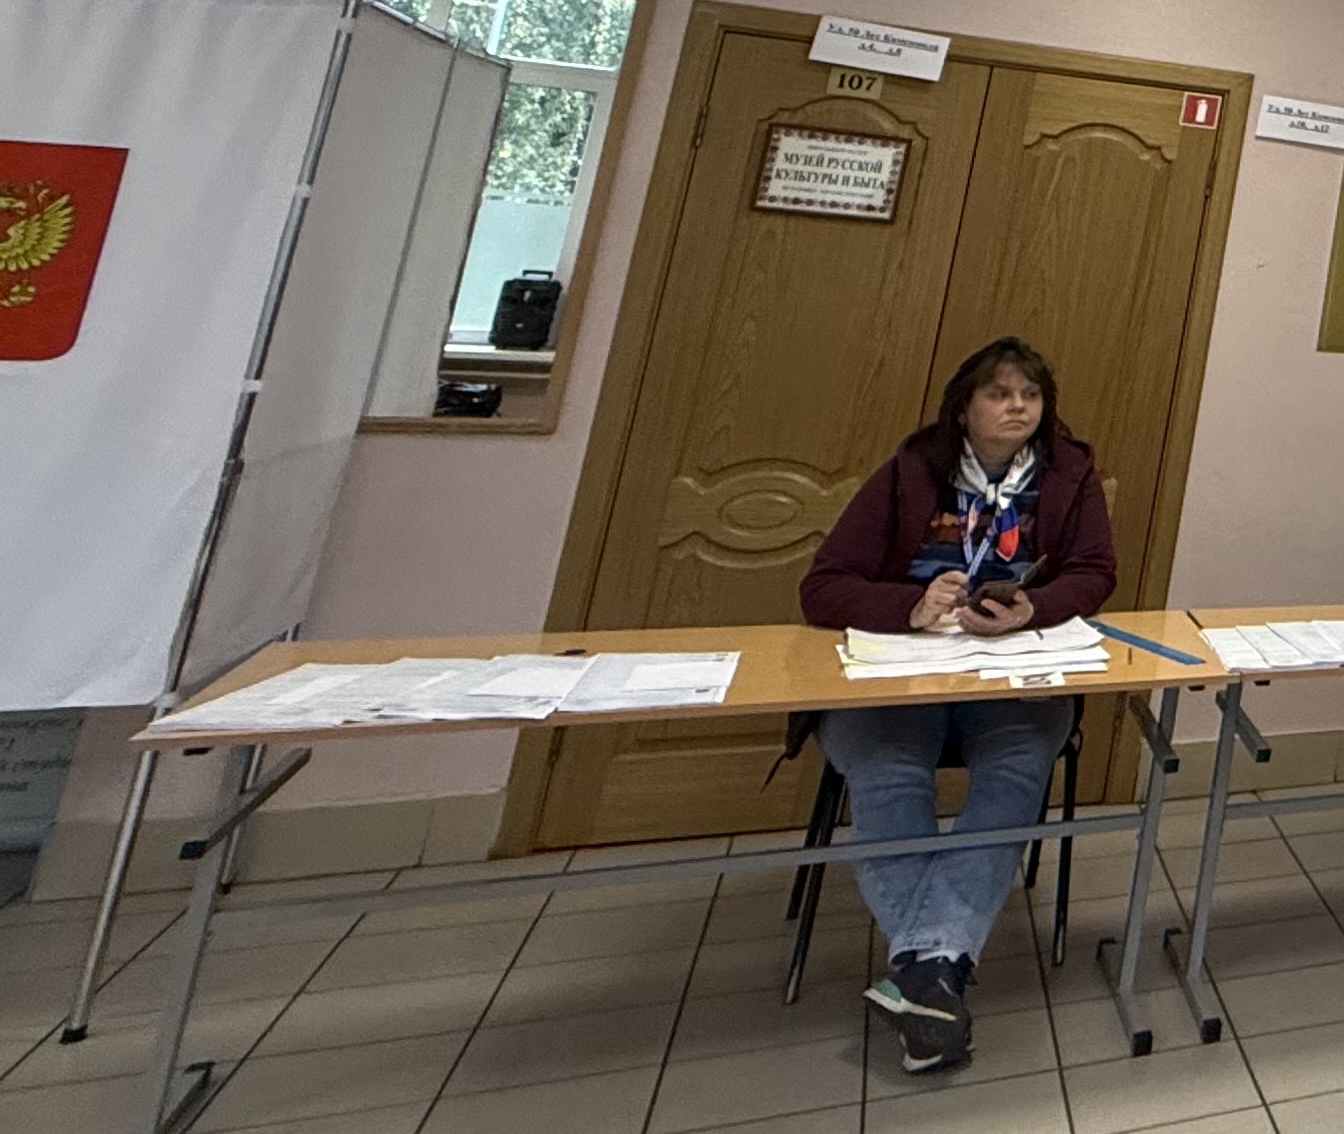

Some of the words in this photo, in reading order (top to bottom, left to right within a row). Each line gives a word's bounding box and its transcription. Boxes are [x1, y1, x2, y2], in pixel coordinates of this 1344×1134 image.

[836, 72, 877, 91] 107
[783, 151, 824, 167] МУЗЕЙ
[826, 157, 883, 174] РУССКОЙ
[774, 168, 839, 186] КУЛЬТУРЫ
[841, 175, 850, 186] И
[852, 176, 885, 190] БЫТА
